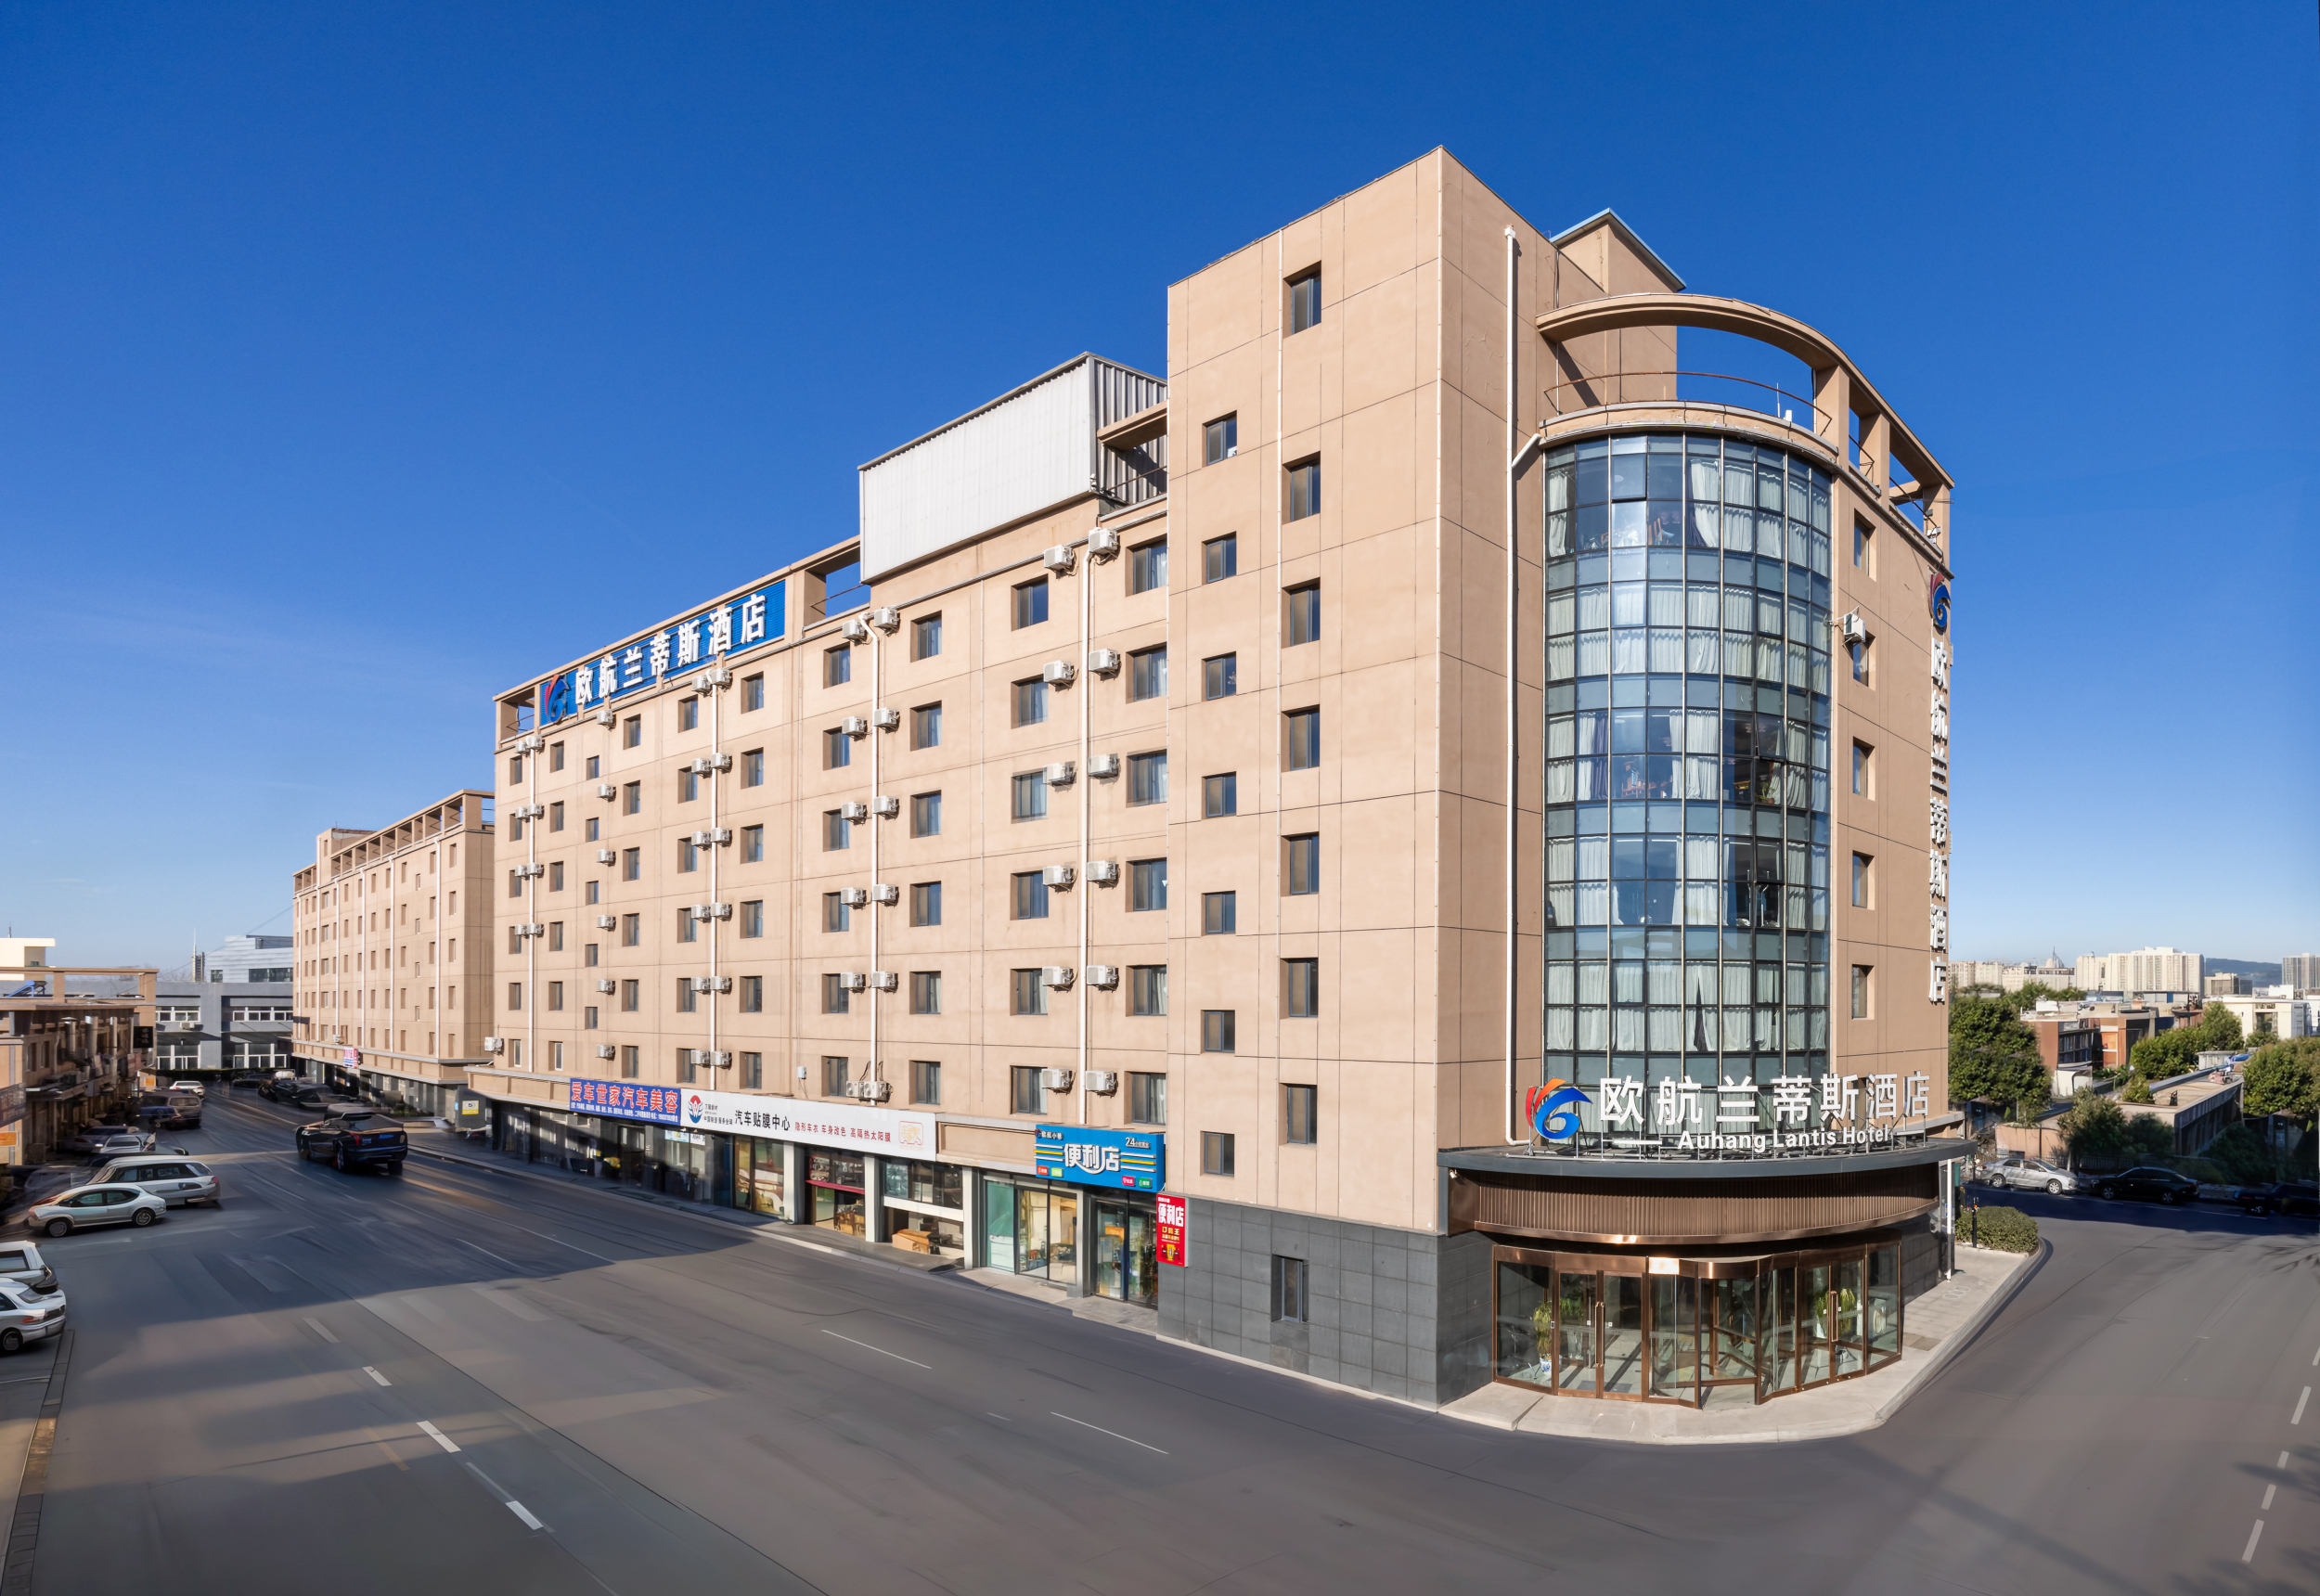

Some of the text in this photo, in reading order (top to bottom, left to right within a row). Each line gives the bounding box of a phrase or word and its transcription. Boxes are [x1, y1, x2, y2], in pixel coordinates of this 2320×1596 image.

[575, 594, 767, 704] 欧航兰蒂斯酒店
[1928, 637, 1948, 1002] 欧航兰蒂斯酒店
[571, 1081, 678, 1113] 爱车世家汽车美容
[1600, 1070, 1930, 1126] 欧航兰蒂斯酒店
[735, 1110, 791, 1131] 汽车贴膜中心
[794, 1121, 818, 1133] 隐形车衣
[821, 1124, 846, 1138] 车身改色
[850, 1126, 892, 1142] 高隔热太阳膜
[1677, 1123, 1889, 1153] Auhang Lantis Hotel
[1063, 1143, 1121, 1174] 便利店
[1158, 1203, 1184, 1227] 便利店
